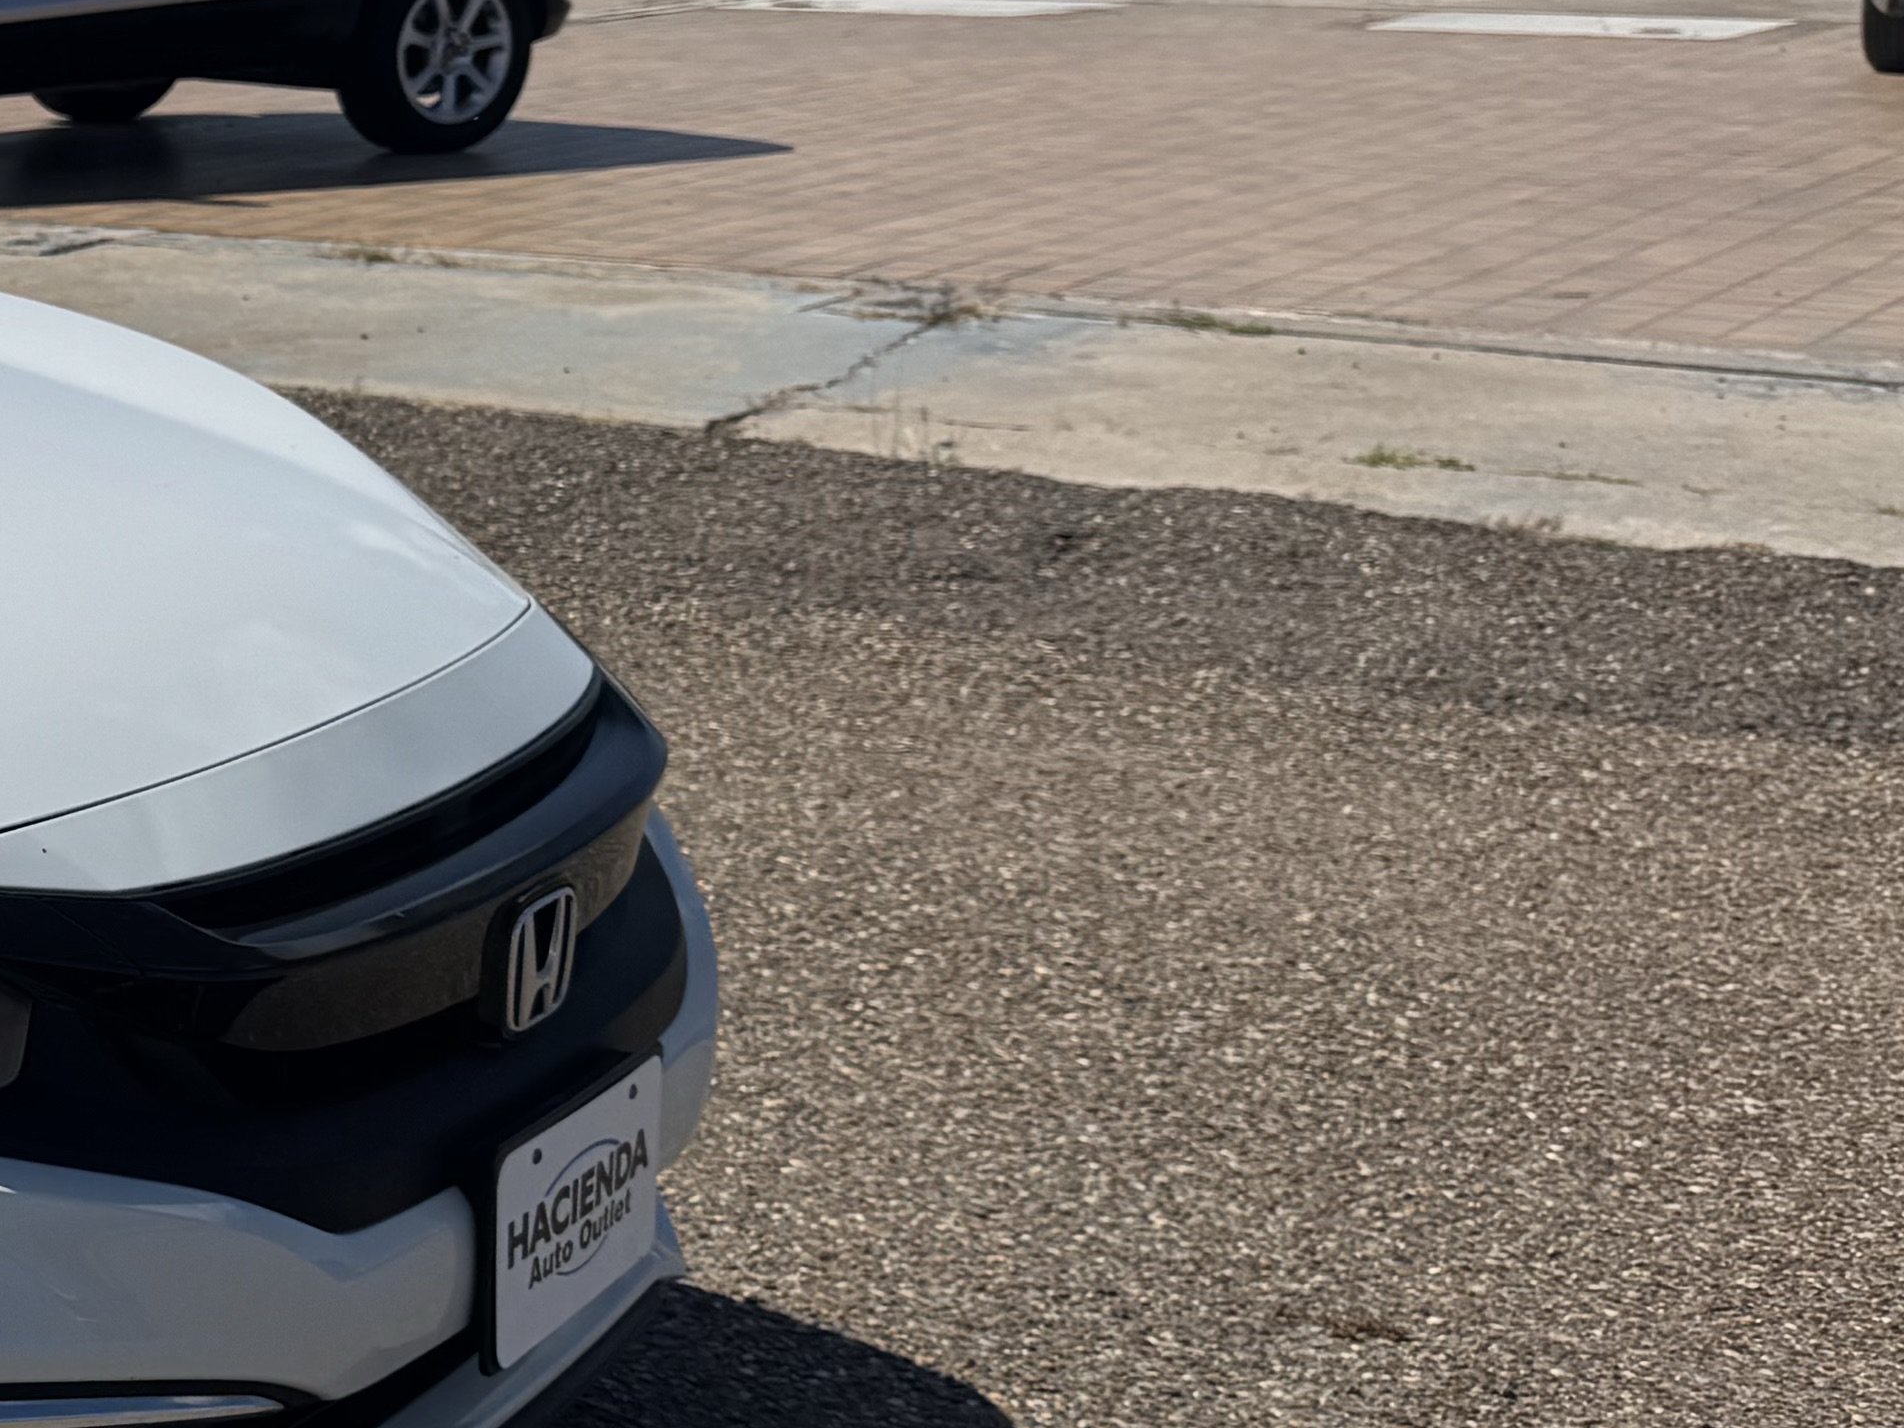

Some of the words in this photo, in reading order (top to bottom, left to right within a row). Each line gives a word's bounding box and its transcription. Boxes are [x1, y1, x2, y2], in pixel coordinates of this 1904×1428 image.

[507, 1127, 649, 1270] HACIENDA
[528, 1238, 574, 1290] Auto
[579, 1187, 632, 1251] Outlet
